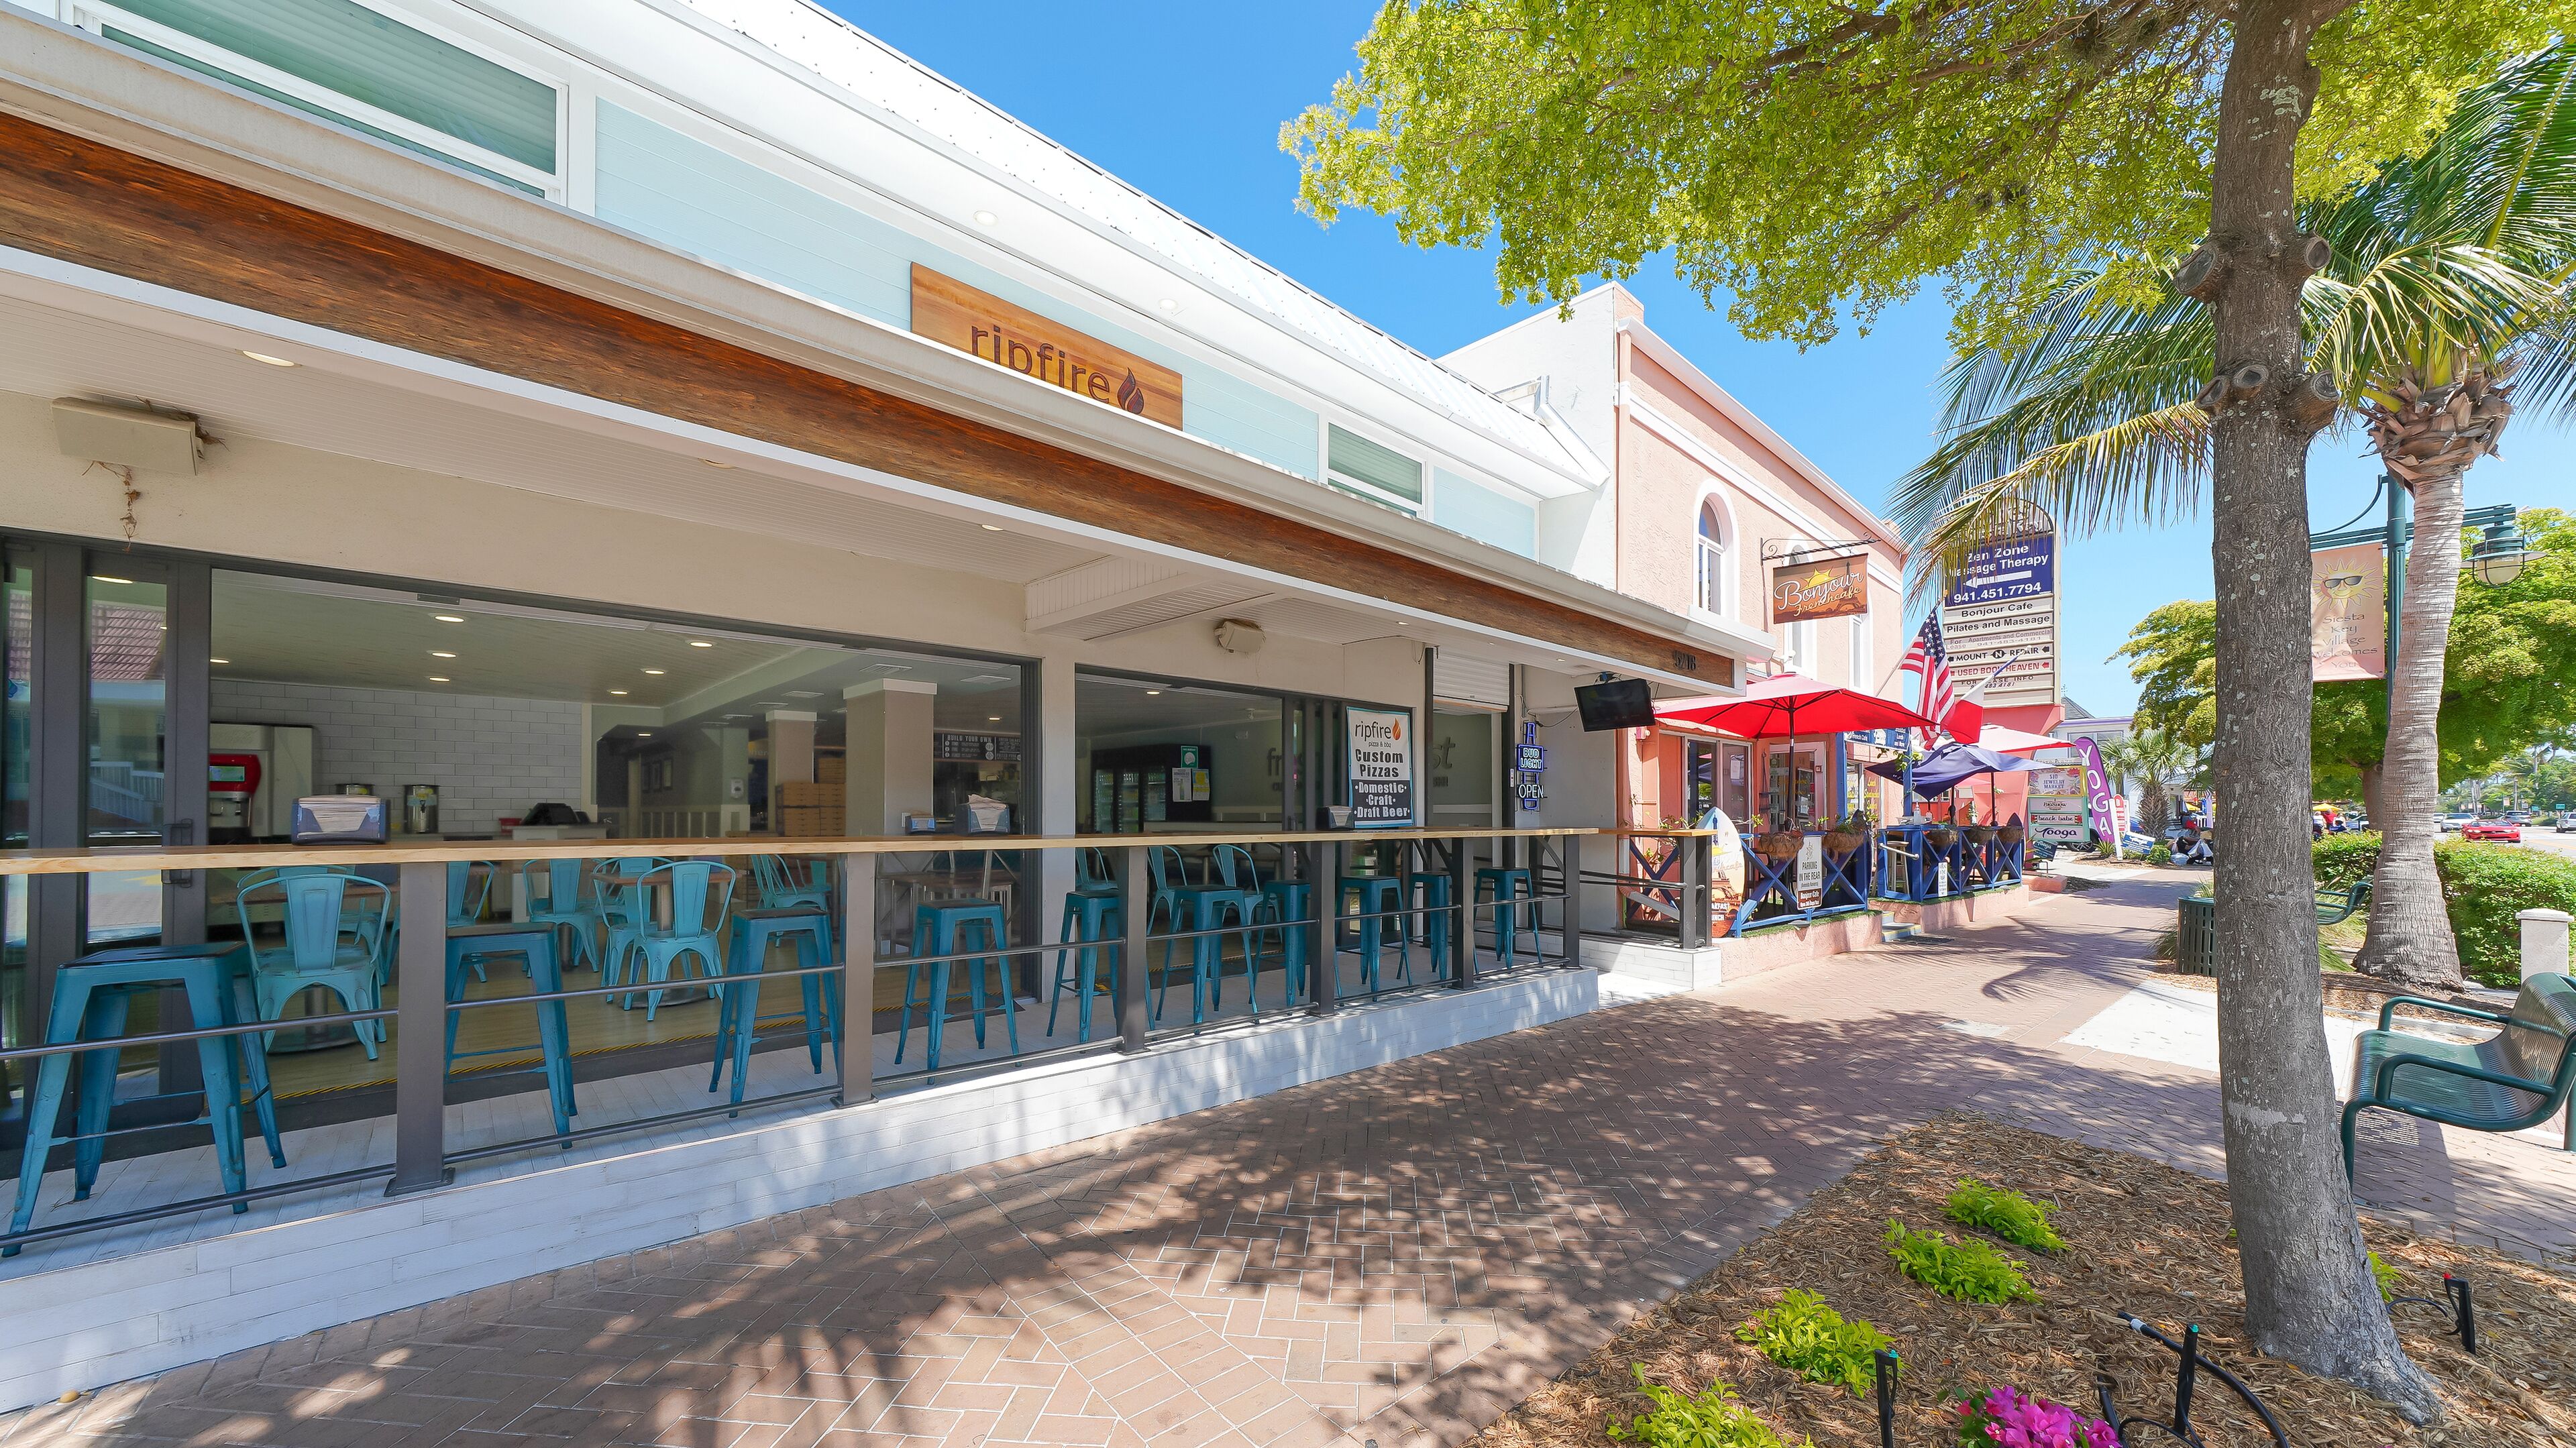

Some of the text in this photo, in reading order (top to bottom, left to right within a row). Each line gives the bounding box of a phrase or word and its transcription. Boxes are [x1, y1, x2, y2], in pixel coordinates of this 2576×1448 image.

[971, 325, 1110, 404] ripfire
[1967, 545, 2029, 563] Zen Zone
[2000, 555, 2049, 569] Therapy
[1774, 572, 1864, 610] Bonjour
[1953, 581, 2042, 604] 941.451.7794
[1962, 602, 2033, 618] Bonjour Cafe
[1947, 616, 2050, 633] Pilates and Massage
[2322, 613, 2365, 624] Siesta
[1968, 635, 2002, 643] Apartments
[2015, 628, 2053, 638] Commercial
[2331, 625, 2357, 636] Key
[2322, 634, 2366, 647] Village
[1956, 652, 1988, 662] MOUNT
[2009, 647, 2039, 657] REPAIR
[2313, 648, 2377, 657] Welcomes
[1957, 667, 1978, 677] USED
[2006, 662, 2040, 672] HEAVEN
[1354, 720, 1391, 742] ripfire
[1355, 748, 1403, 763] Custom
[1523, 747, 1540, 759] BUD
[1359, 764, 1399, 777] Pizzas
[1520, 758, 1542, 769] LIGHT
[1519, 784, 1544, 799] OPEN
[2078, 744, 2113, 837] YOGA
[1802, 860, 1818, 871] PARKING
[1799, 873, 1803, 882] IN
[1811, 871, 1821, 881] REAR
[1711, 902, 1730, 910] AKFAST
